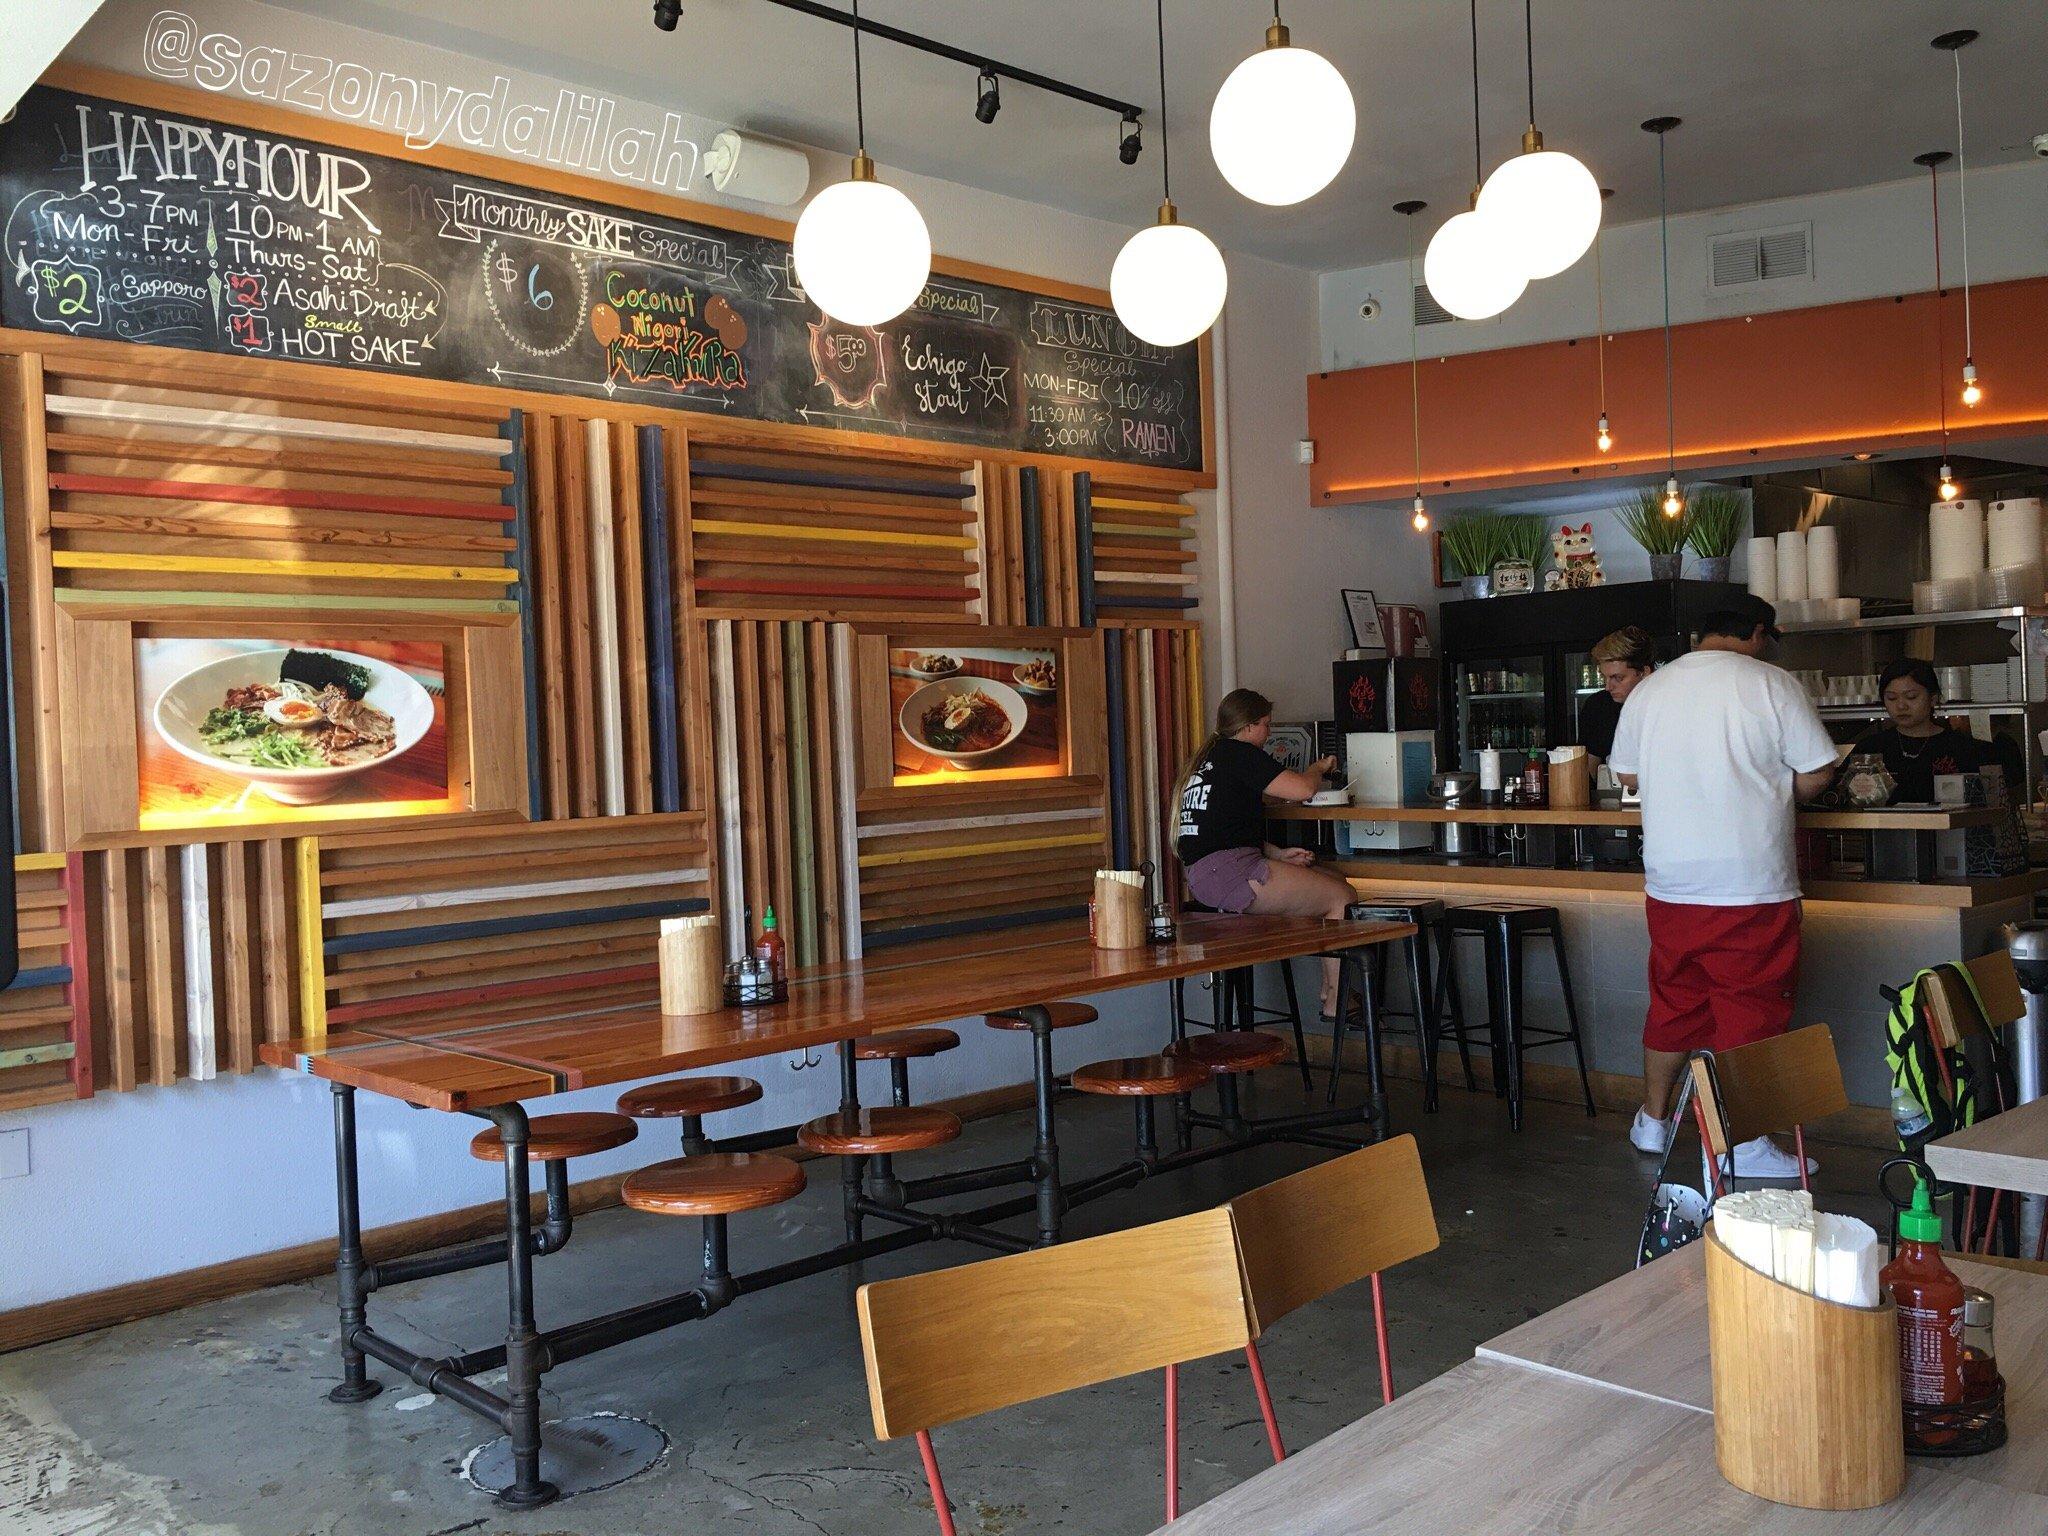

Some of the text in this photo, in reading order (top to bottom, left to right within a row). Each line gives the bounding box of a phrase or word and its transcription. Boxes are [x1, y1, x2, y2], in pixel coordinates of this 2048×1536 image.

[76, 105, 234, 192] HAPPY
[234, 132, 382, 235] HOUR
[456, 192, 566, 241] Monthly
[565, 210, 635, 258] SAKE
[638, 229, 724, 270] Special
[41, 265, 92, 316] $2
[122, 274, 208, 299] Sapporo
[231, 274, 263, 306] $2
[273, 278, 427, 328] Asahi Draft
[605, 270, 695, 318] Coconut
[918, 285, 980, 316] Special
[304, 313, 363, 334] Small
[630, 311, 690, 345] Nigori
[281, 327, 422, 366] HOT SAKE
[901, 334, 968, 390] Echigo
[1063, 350, 1138, 378] Special
[914, 379, 972, 415] Stout
[1022, 372, 1099, 401] MON-FRI
[1151, 390, 1176, 414] off
[1029, 405, 1065, 424] 11:30
[1067, 407, 1087, 423] AM
[1120, 417, 1176, 455] RAMEN
